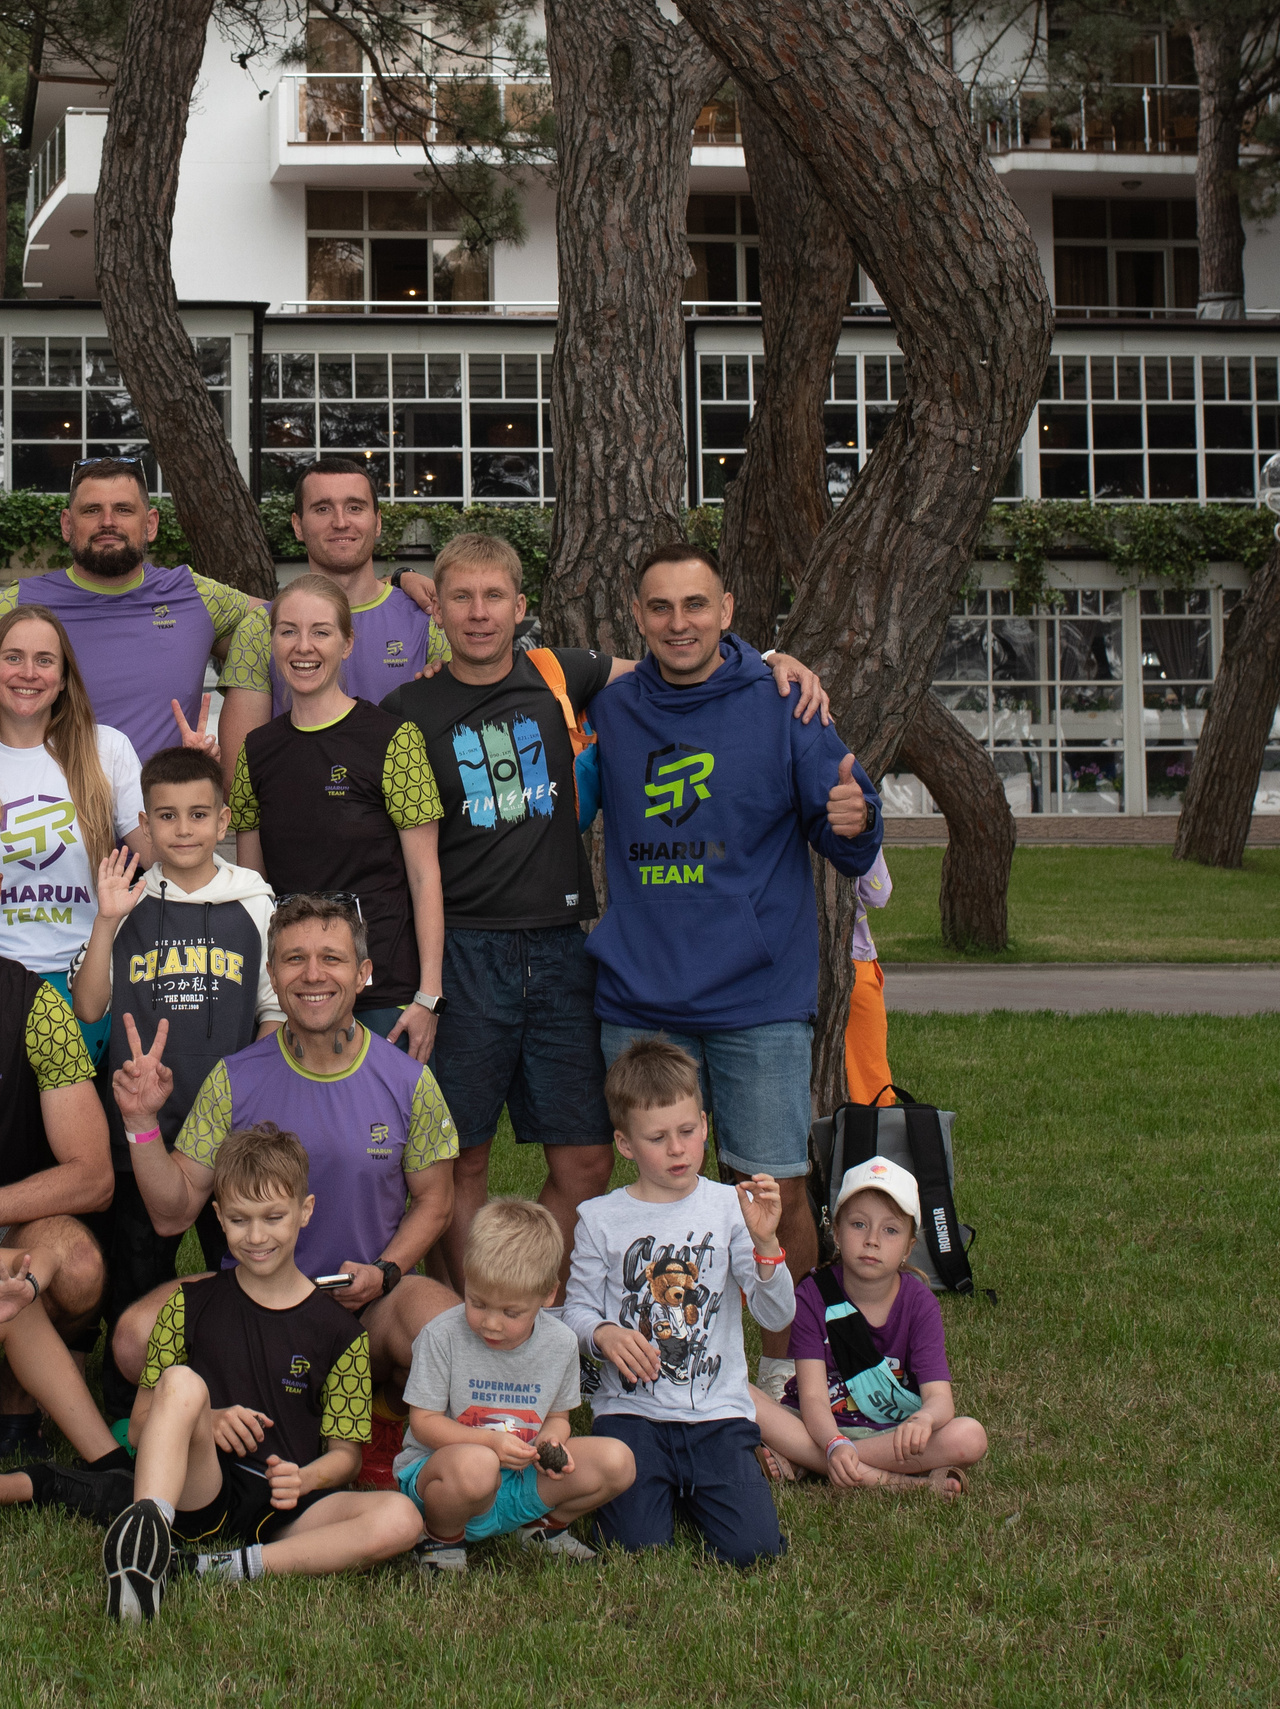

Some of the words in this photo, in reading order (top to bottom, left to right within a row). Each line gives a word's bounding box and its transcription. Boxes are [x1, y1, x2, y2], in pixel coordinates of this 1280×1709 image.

[462, 781, 558, 815] FINISHER
[628, 841, 726, 861] SHARUN
[639, 864, 705, 885] TEAM
[1, 884, 91, 906] HARUN
[2, 907, 73, 926] TEAM
[129, 945, 244, 986] CHANGE
[164, 994, 179, 1003] THE
[180, 993, 204, 1003] WORLD
[932, 1207, 952, 1253] IRONSTAR
[285, 1385, 302, 1394] TEAM
[468, 1378, 542, 1394] SUPERMAN'S
[471, 1391, 497, 1402] BEST
[499, 1394, 538, 1404] FRIEND
